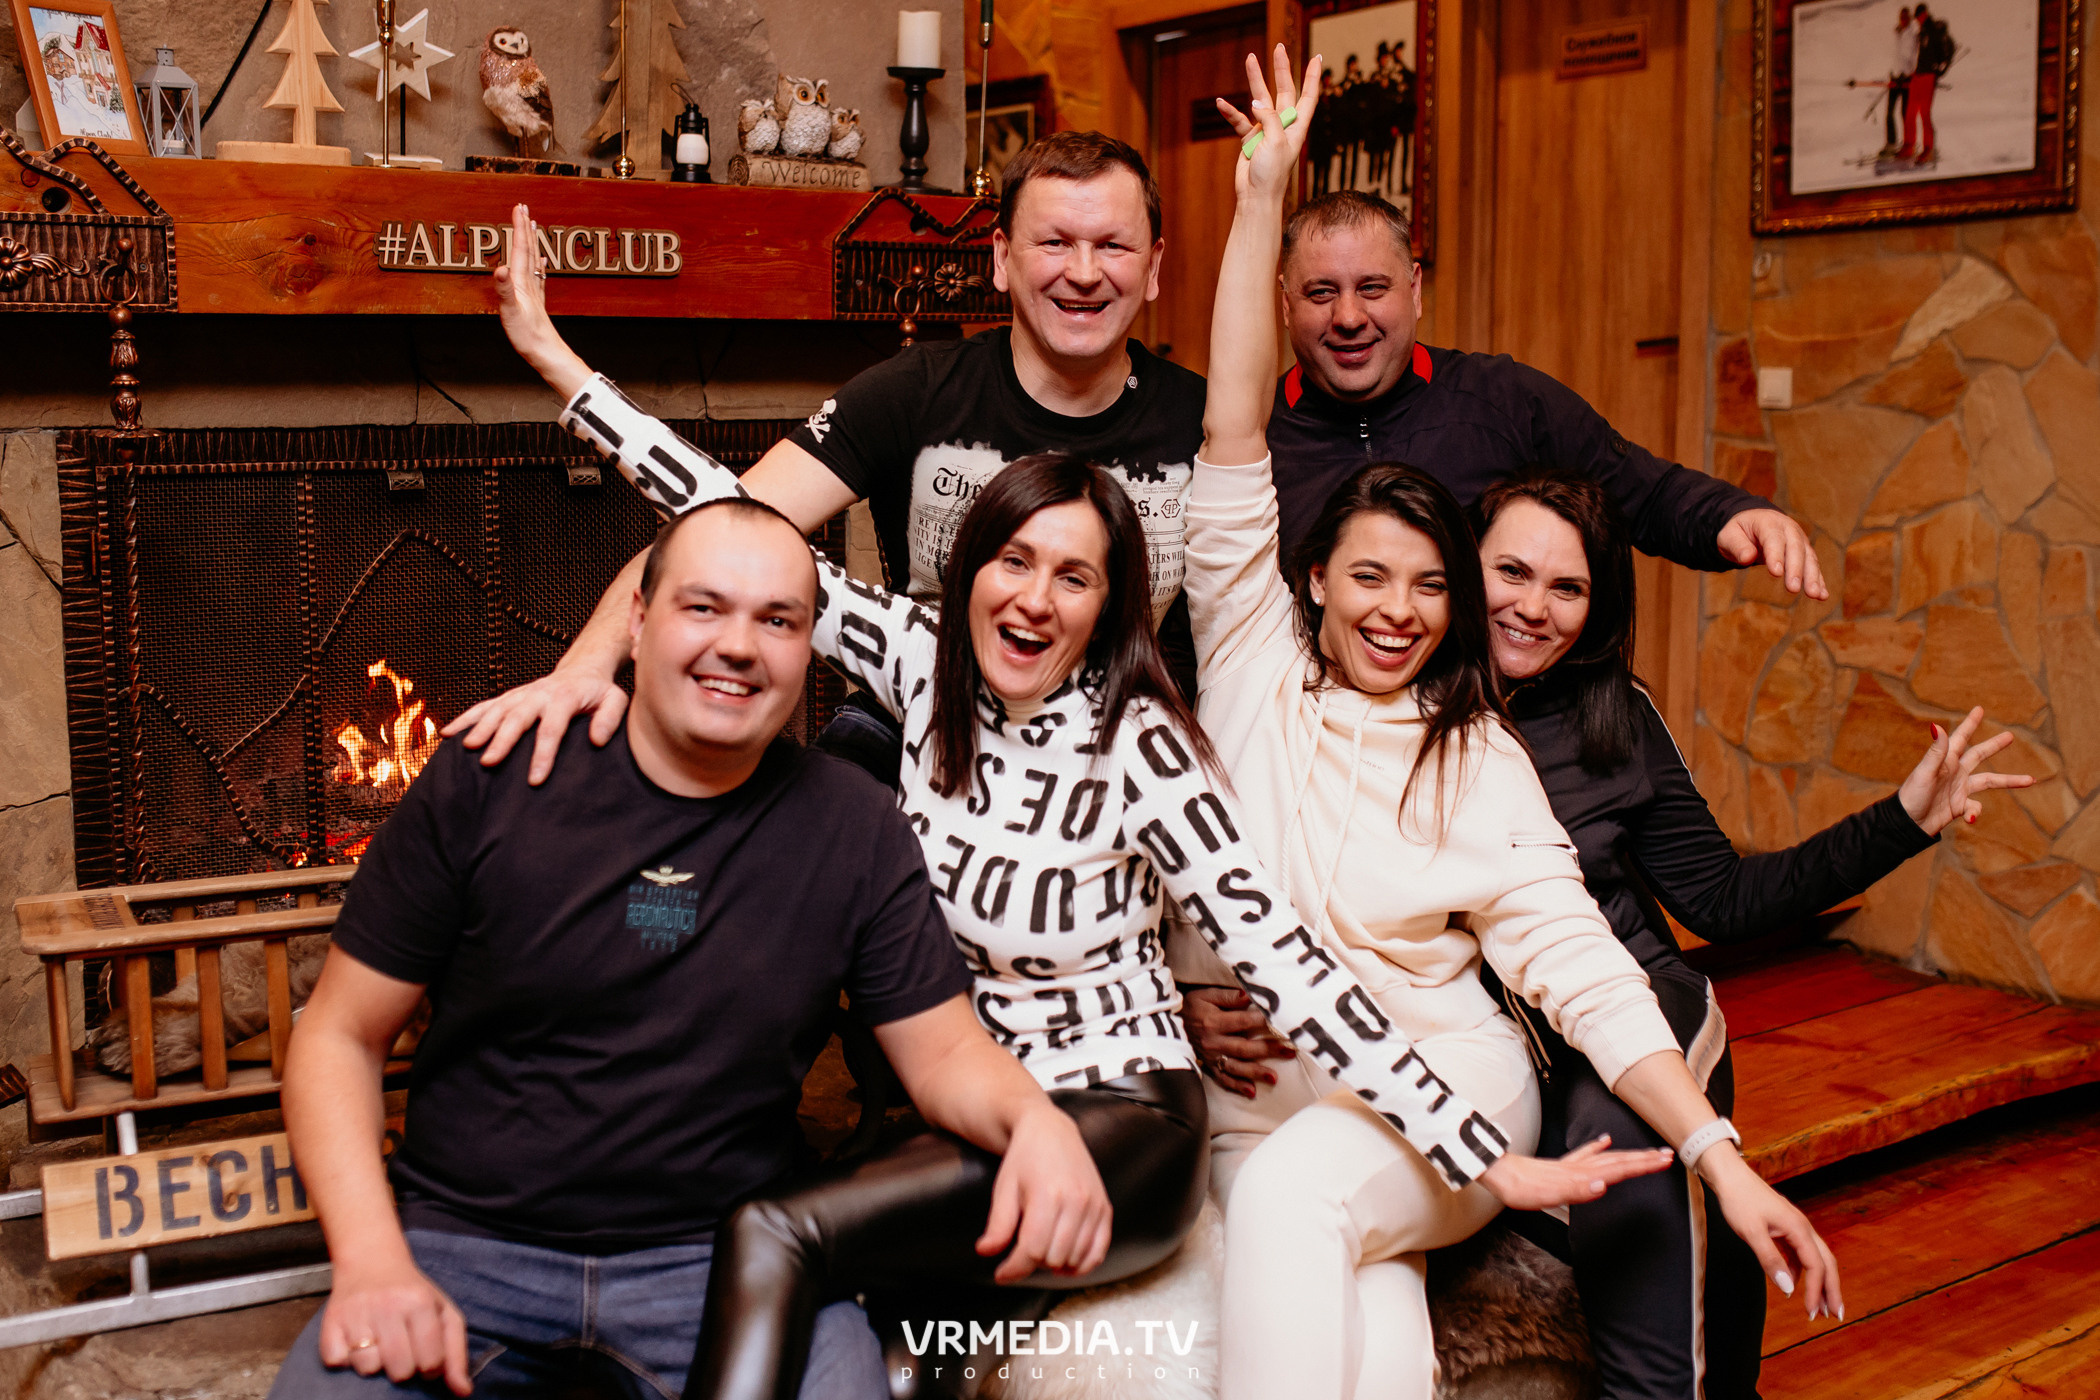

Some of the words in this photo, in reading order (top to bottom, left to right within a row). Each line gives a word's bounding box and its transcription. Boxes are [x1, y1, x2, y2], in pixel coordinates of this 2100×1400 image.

[761, 160, 861, 188] Welcome
[932, 467, 984, 501] The
[95, 1144, 308, 1240] ВЕСН
